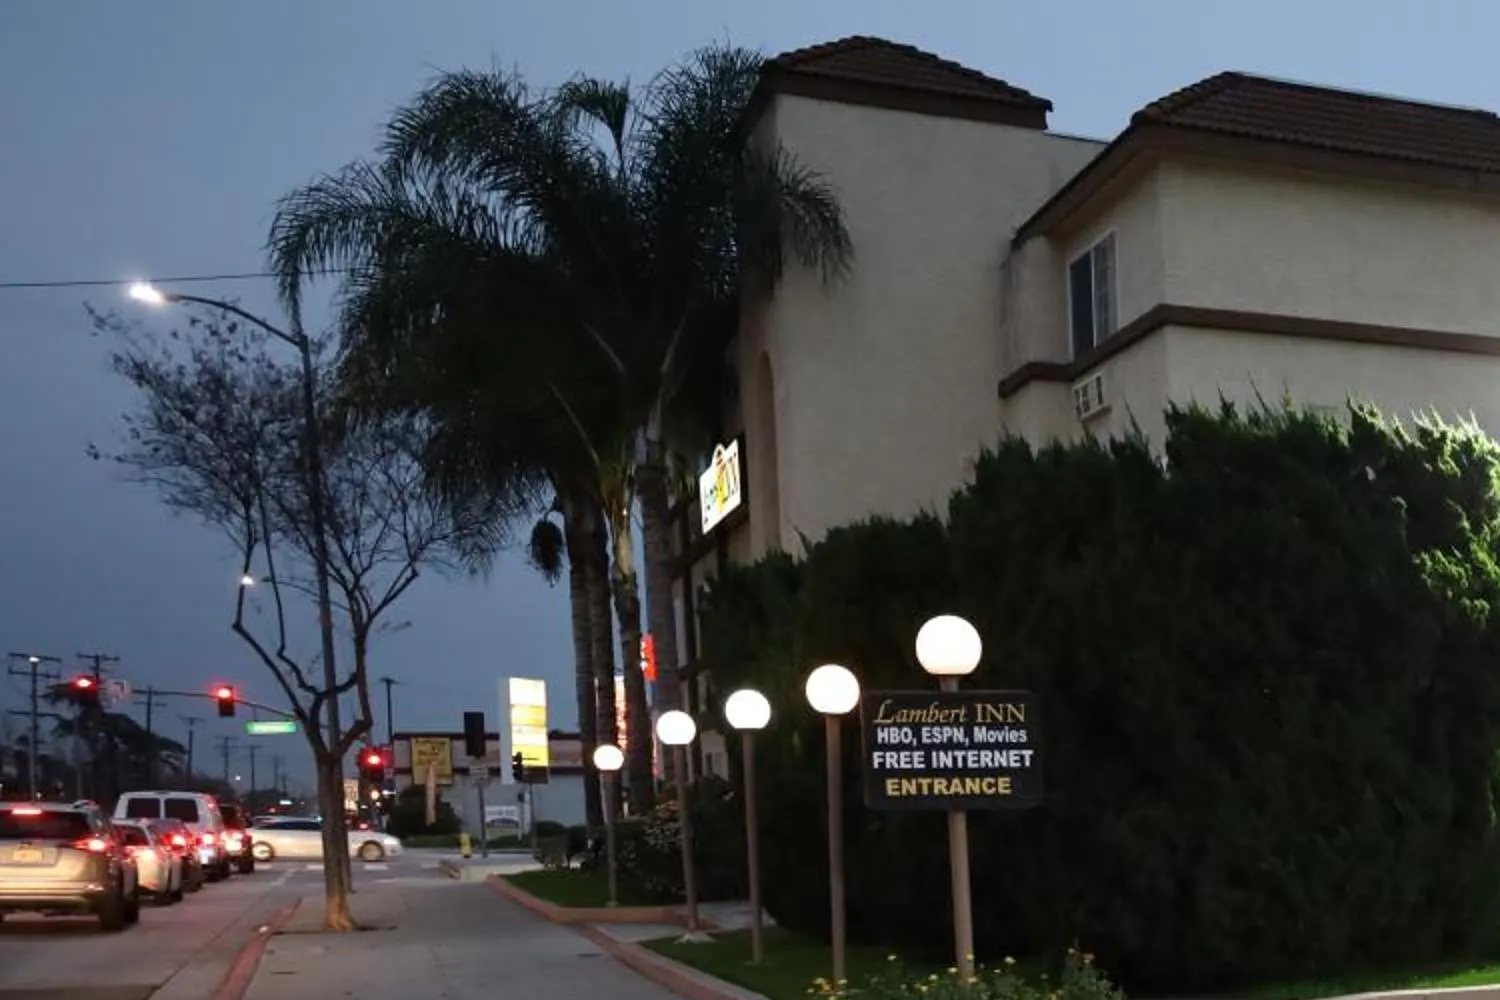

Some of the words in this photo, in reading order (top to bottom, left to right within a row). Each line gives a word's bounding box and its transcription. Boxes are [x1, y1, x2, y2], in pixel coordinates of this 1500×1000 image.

[872, 699, 968, 724] Lambert
[975, 703, 1026, 723] INN
[876, 726, 918, 746] HBO,
[921, 726, 970, 745] ESPN,
[973, 726, 1028, 743] Movies
[872, 751, 926, 769] FREE
[931, 750, 1035, 768] INTERNET
[885, 777, 1013, 796] ENTRANCE
